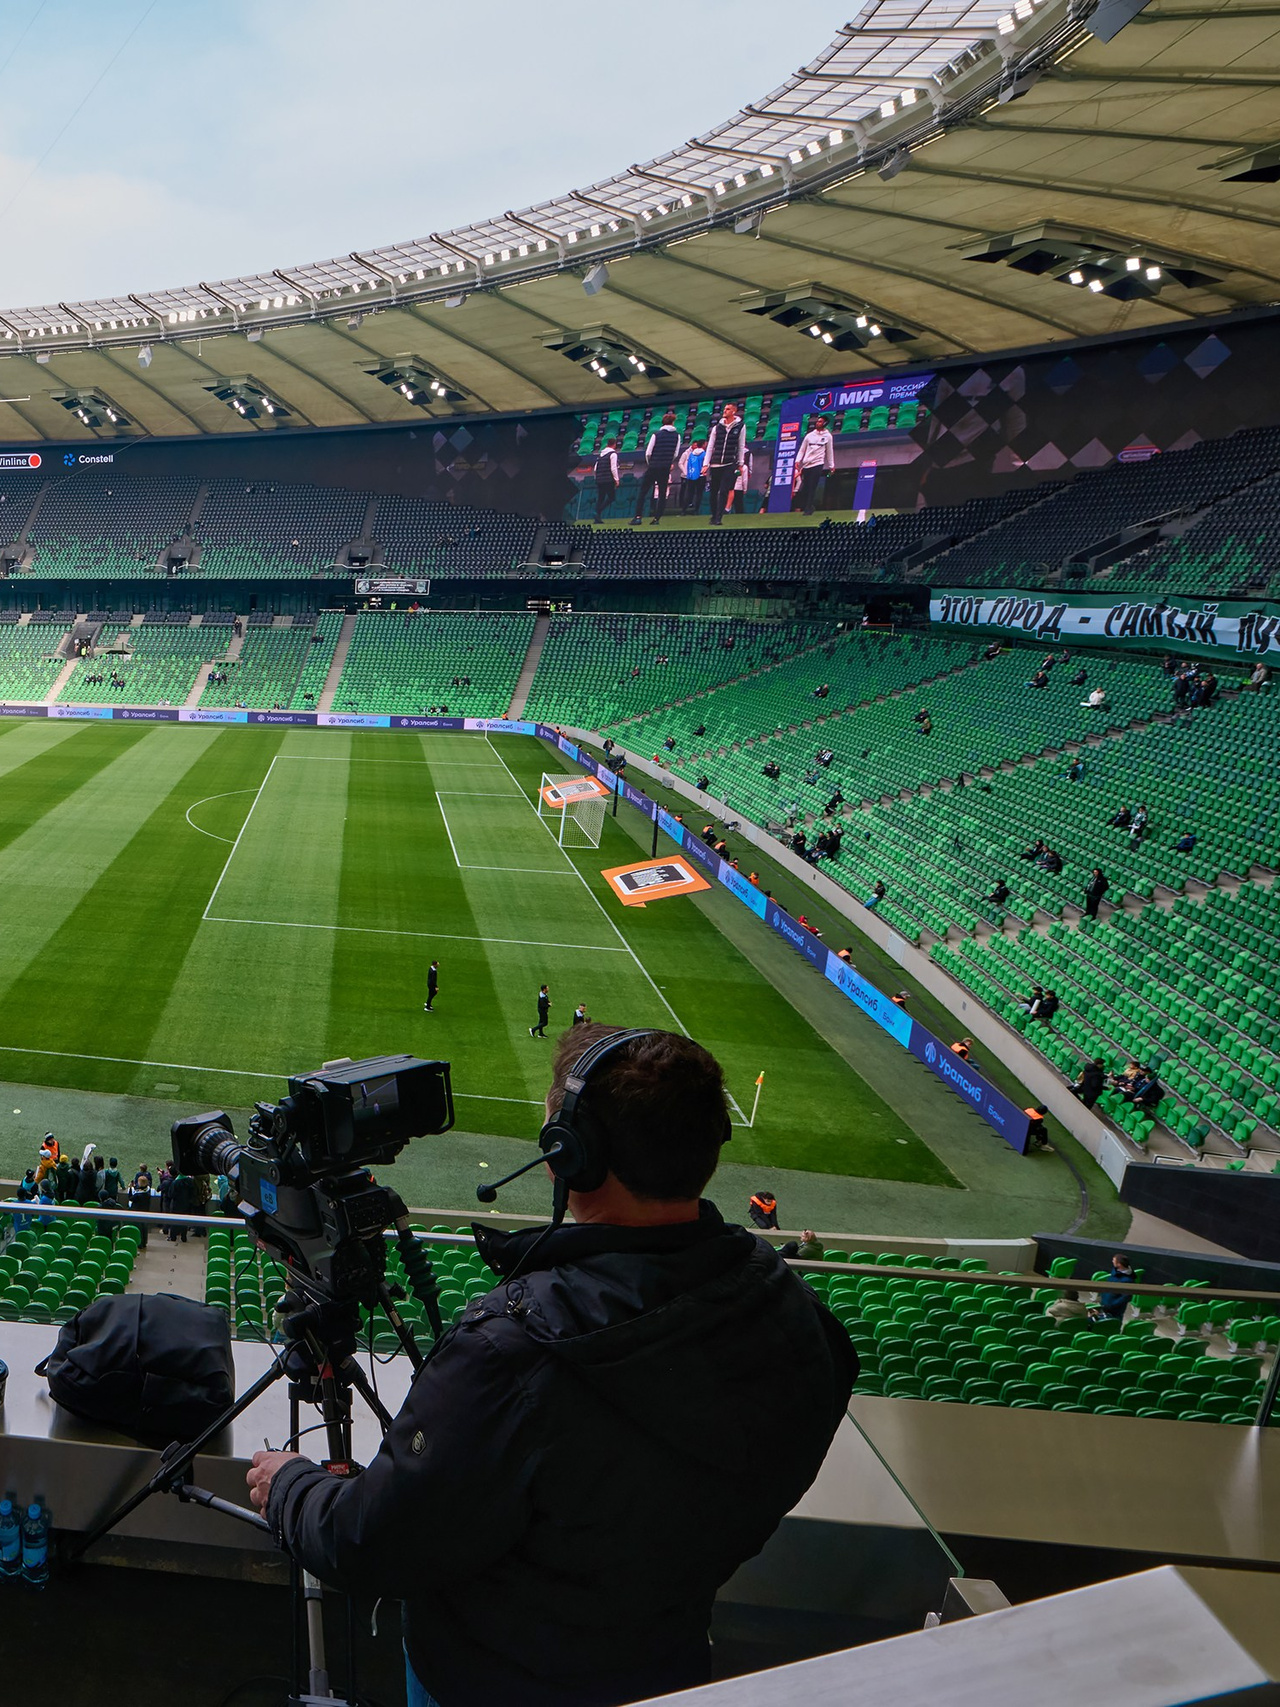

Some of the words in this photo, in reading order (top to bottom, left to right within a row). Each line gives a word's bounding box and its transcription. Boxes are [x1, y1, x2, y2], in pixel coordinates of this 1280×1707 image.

[838, 388, 883, 405] МИР
[78, 455, 114, 464] Constell
[940, 595, 985, 625] ЭТОТ
[987, 596, 1069, 640] ГОРОД
[1104, 602, 1218, 646] САМЫЙ
[130, 711, 156, 720] Уралсиб
[198, 712, 224, 722] Уралсиб
[267, 714, 293, 723] Уралсиб
[337, 716, 365, 726] Уралсиб
[410, 718, 439, 728] Уралсиб
[485, 721, 514, 731] Уралсиб
[780, 918, 805, 947] Уралсиб
[847, 975, 879, 1011] Уралсиб
[882, 1011, 895, 1027] Банк
[938, 1054, 982, 1102] Уралсиб
[987, 1104, 1005, 1126] Банк
